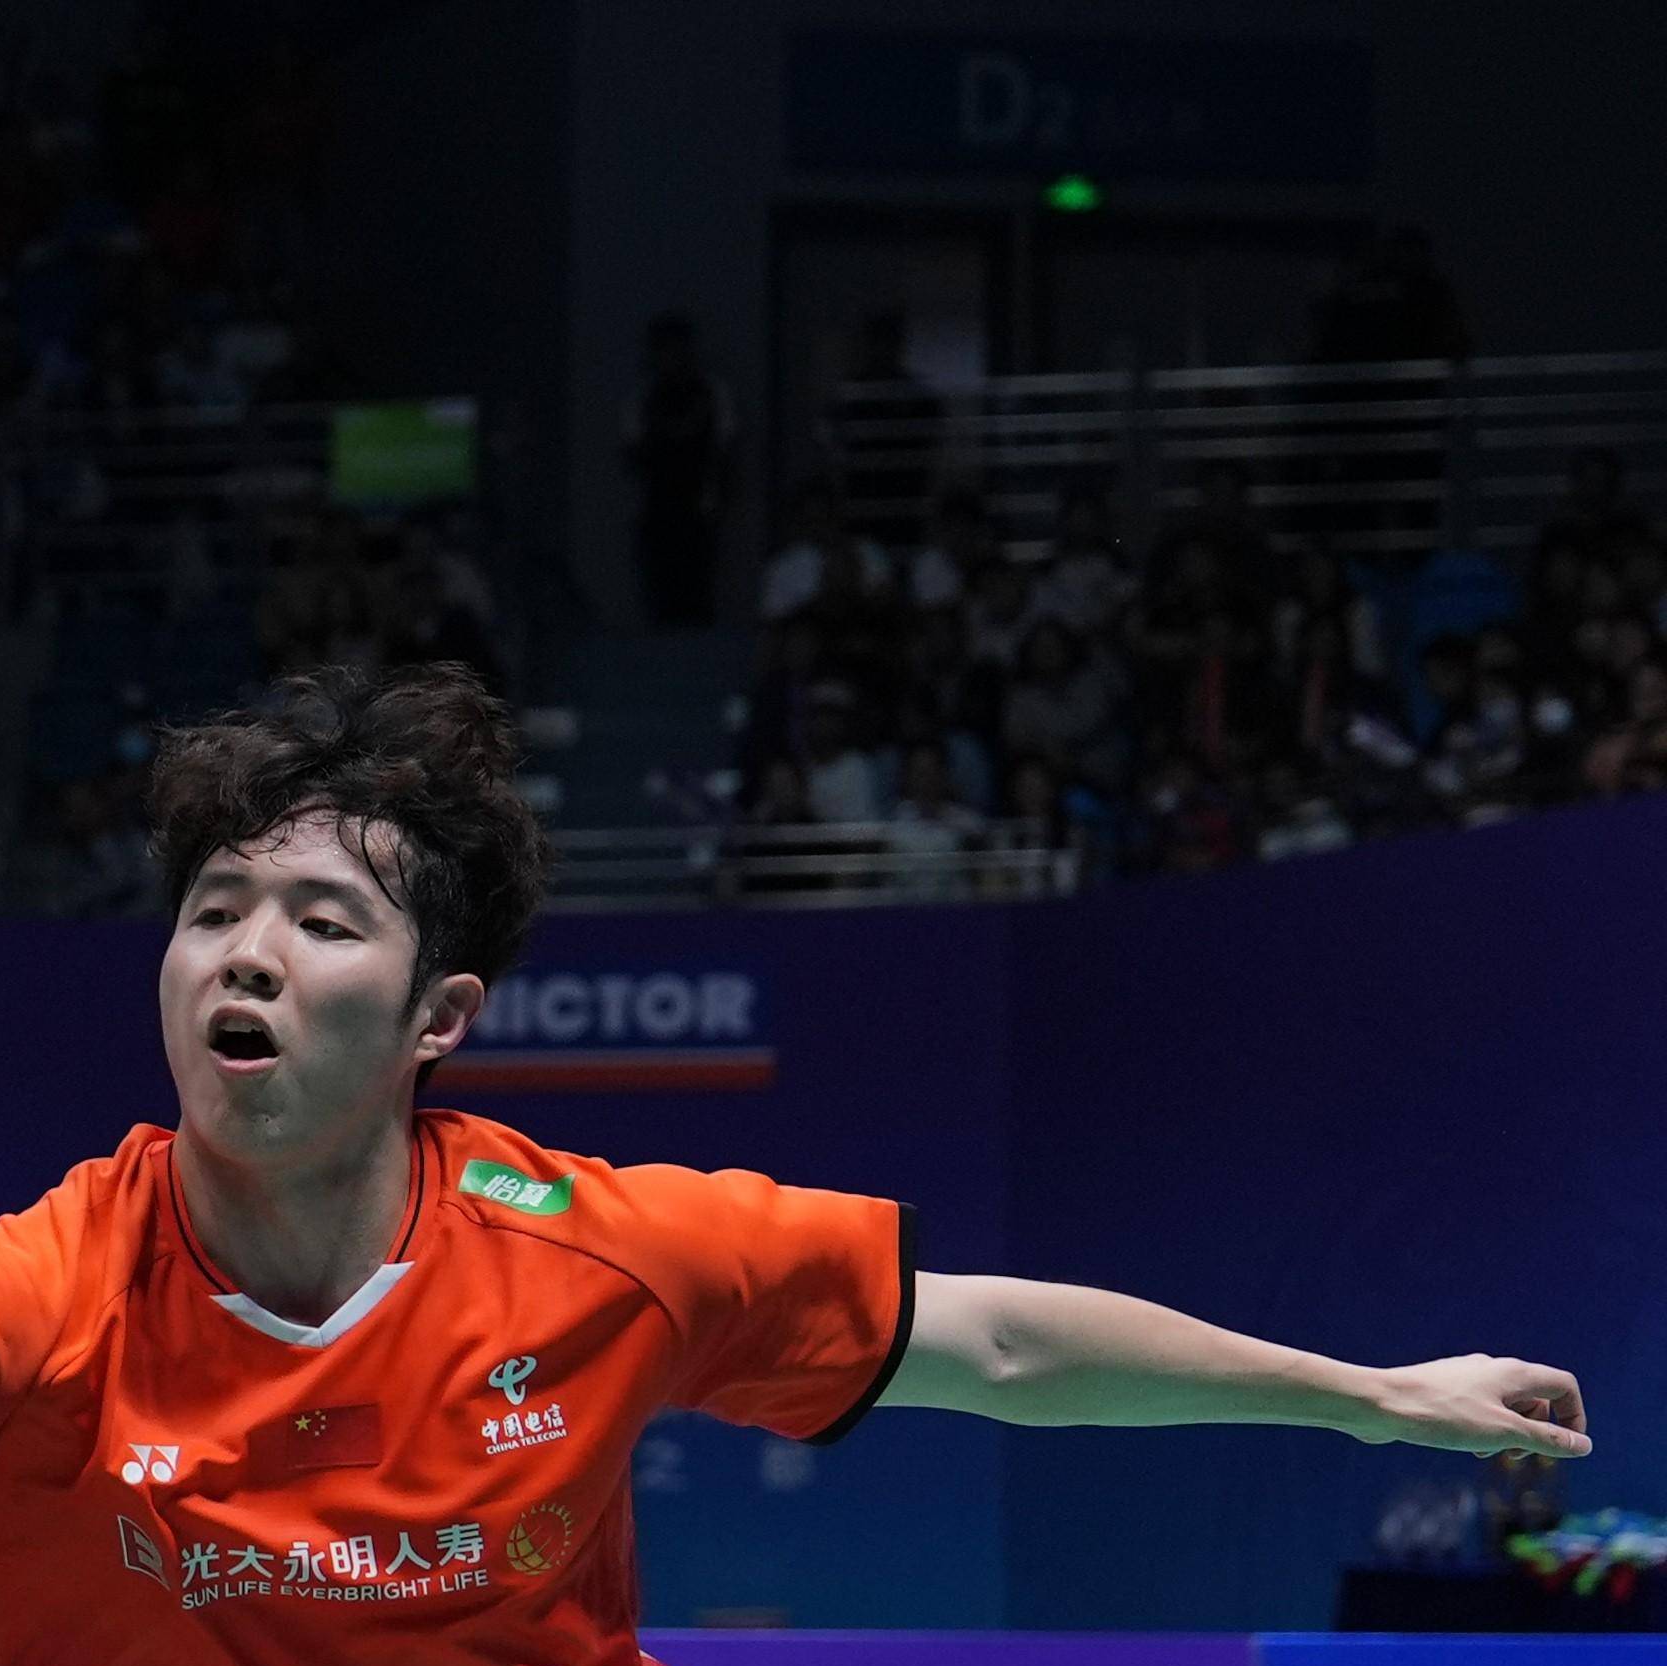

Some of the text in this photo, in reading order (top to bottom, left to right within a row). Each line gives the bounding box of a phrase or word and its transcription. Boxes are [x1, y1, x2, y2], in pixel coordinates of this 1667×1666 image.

[482, 1403, 564, 1444] 中国电信
[486, 1428, 567, 1455] CHINA TELECOM
[181, 1523, 484, 1588] 光大永明人寿
[181, 1569, 489, 1610] SUN LIFE EVERBRIGHT LIFE
